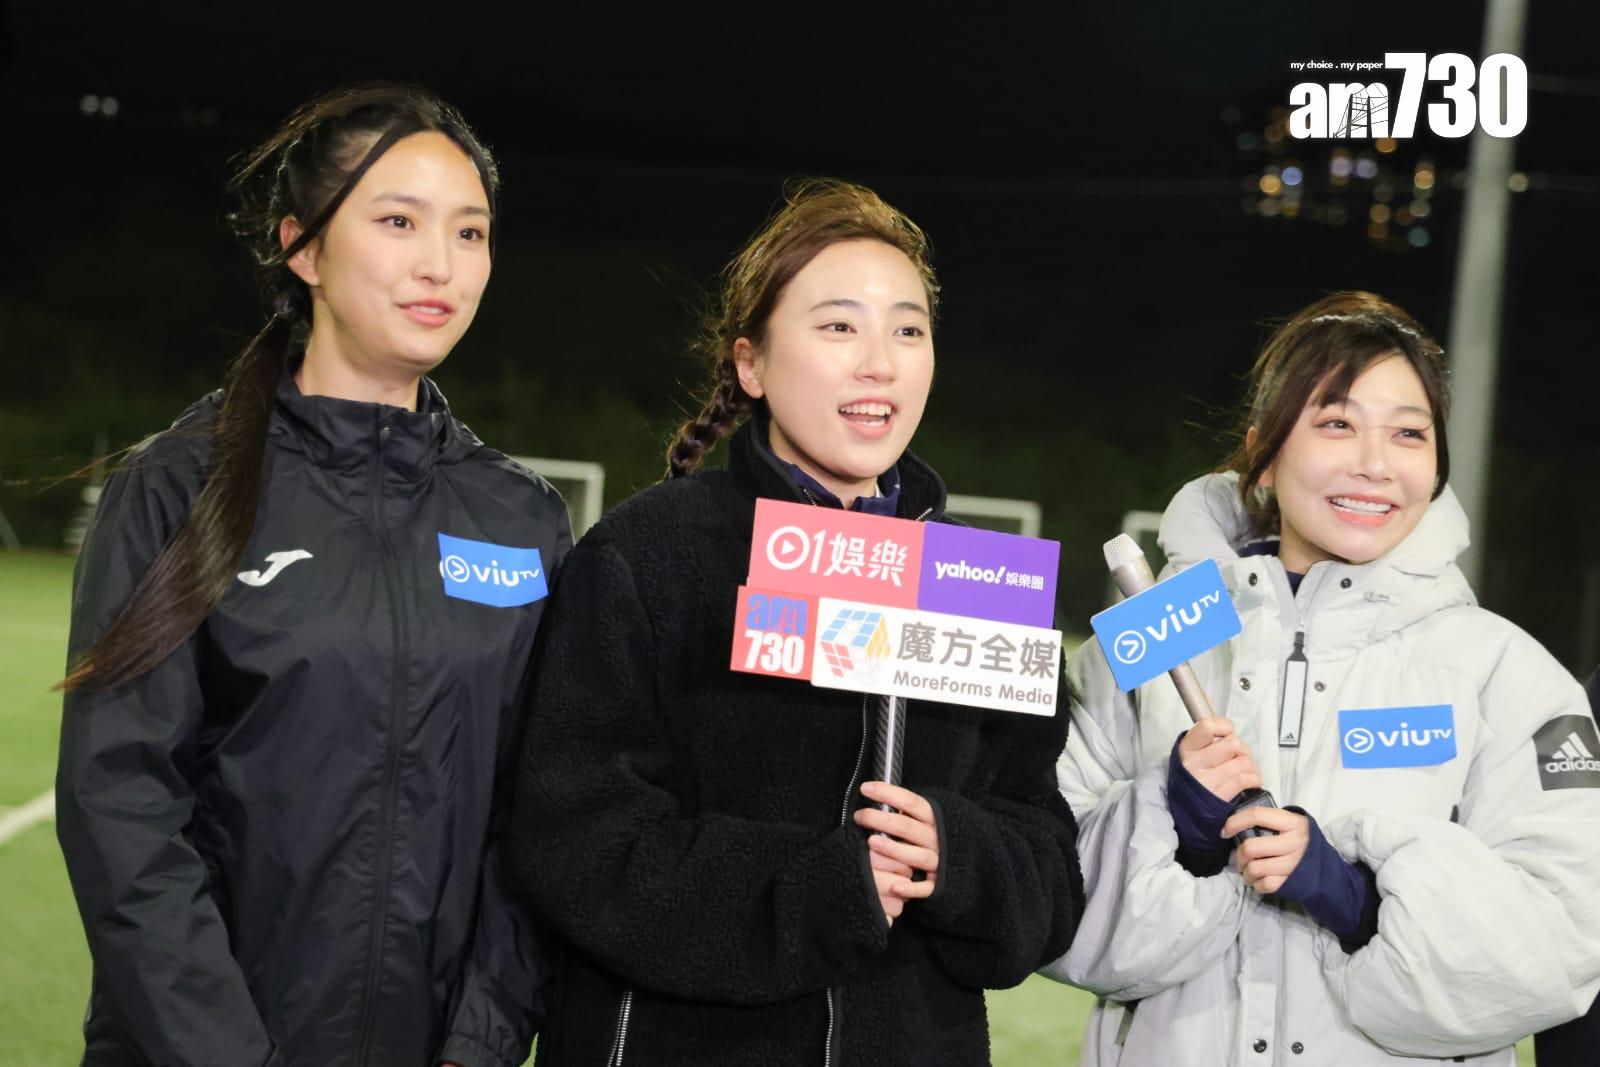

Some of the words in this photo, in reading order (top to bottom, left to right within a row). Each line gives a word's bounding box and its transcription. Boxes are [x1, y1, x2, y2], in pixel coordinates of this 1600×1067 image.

[935, 559, 1006, 584] yahoo!
[745, 593, 808, 635] am
[744, 630, 805, 675] 730
[896, 621, 1057, 680] 魔方全媒
[893, 670, 993, 698] MoreForms
[998, 683, 1054, 706] Media
